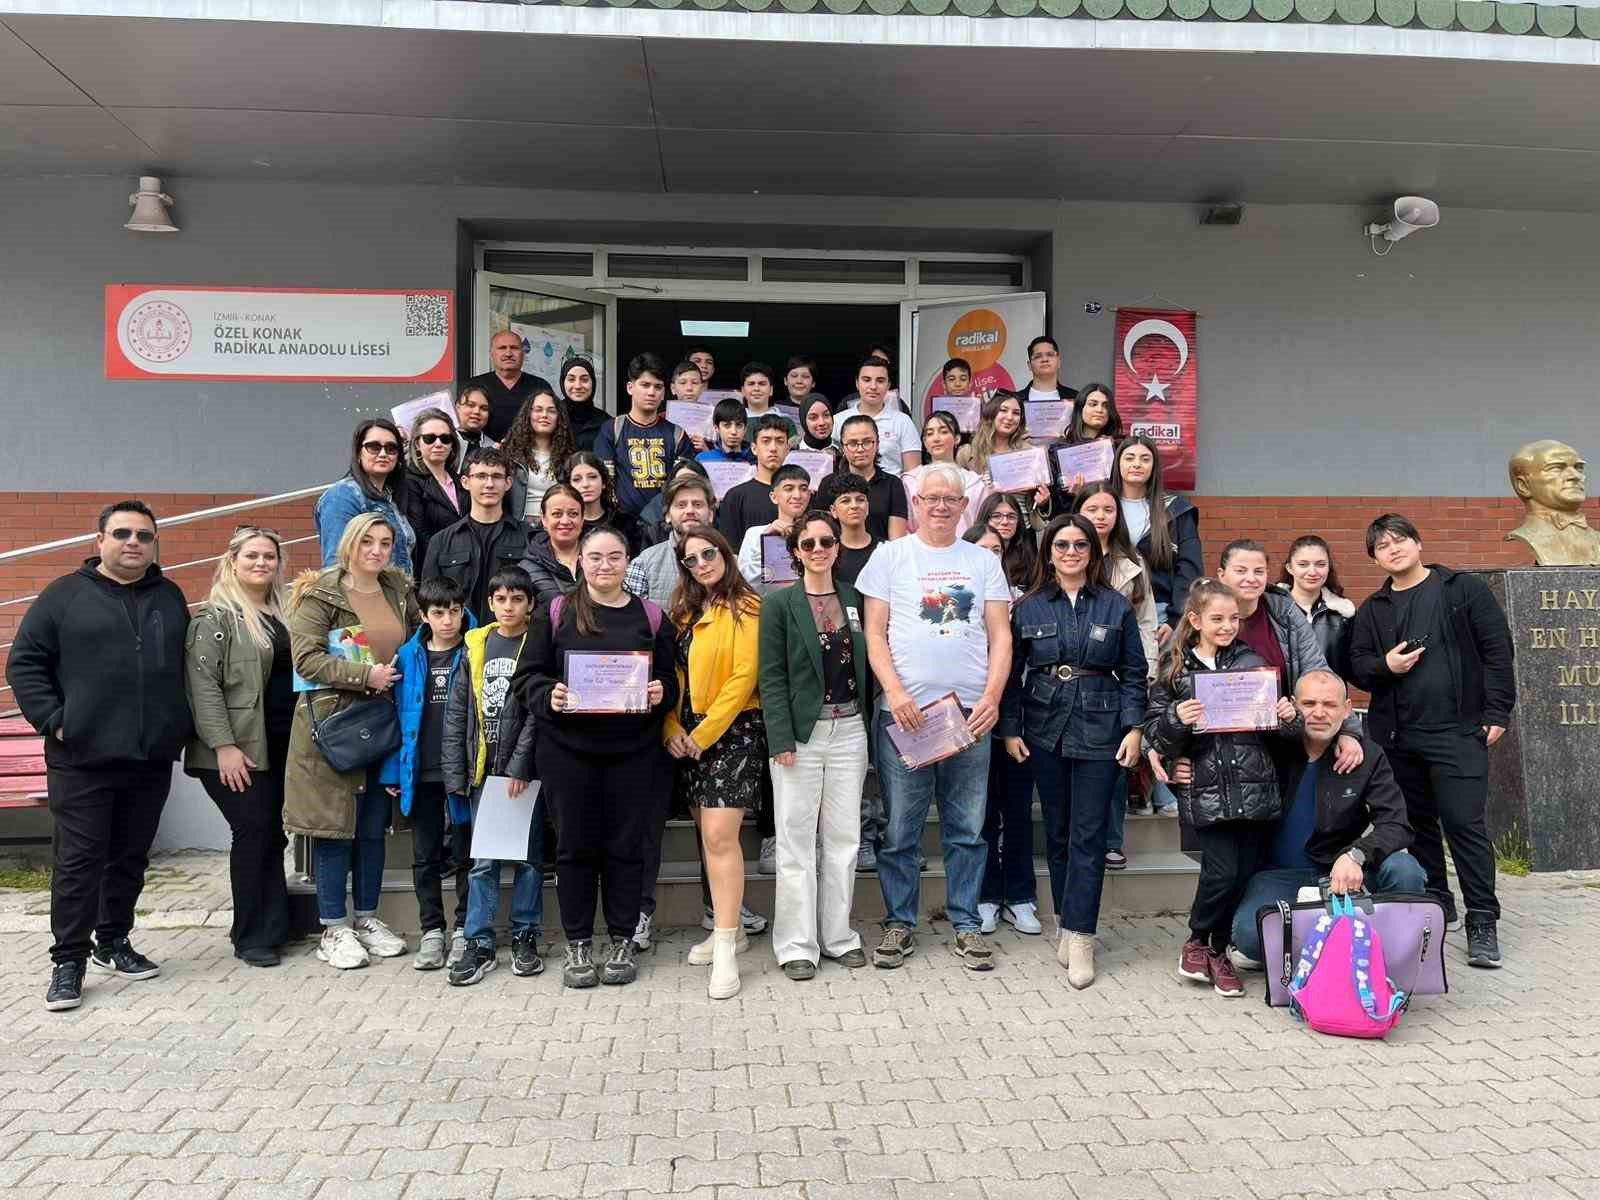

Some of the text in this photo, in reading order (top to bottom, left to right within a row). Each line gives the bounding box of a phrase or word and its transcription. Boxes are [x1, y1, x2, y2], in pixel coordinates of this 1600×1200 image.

[245, 312, 277, 322] KONAK
[214, 323, 302, 340] ÖZEL KONAK
[955, 330, 999, 346] radikal
[214, 340, 390, 356] RADİKAL ANADOLU LİSESİ
[1133, 425, 1178, 438] radikal
[629, 446, 666, 479] 96
[1539, 589, 1600, 610] HAY
[1530, 627, 1568, 649] EN
[1558, 660, 1600, 686] MÜ
[1560, 699, 1600, 725] İLİ
